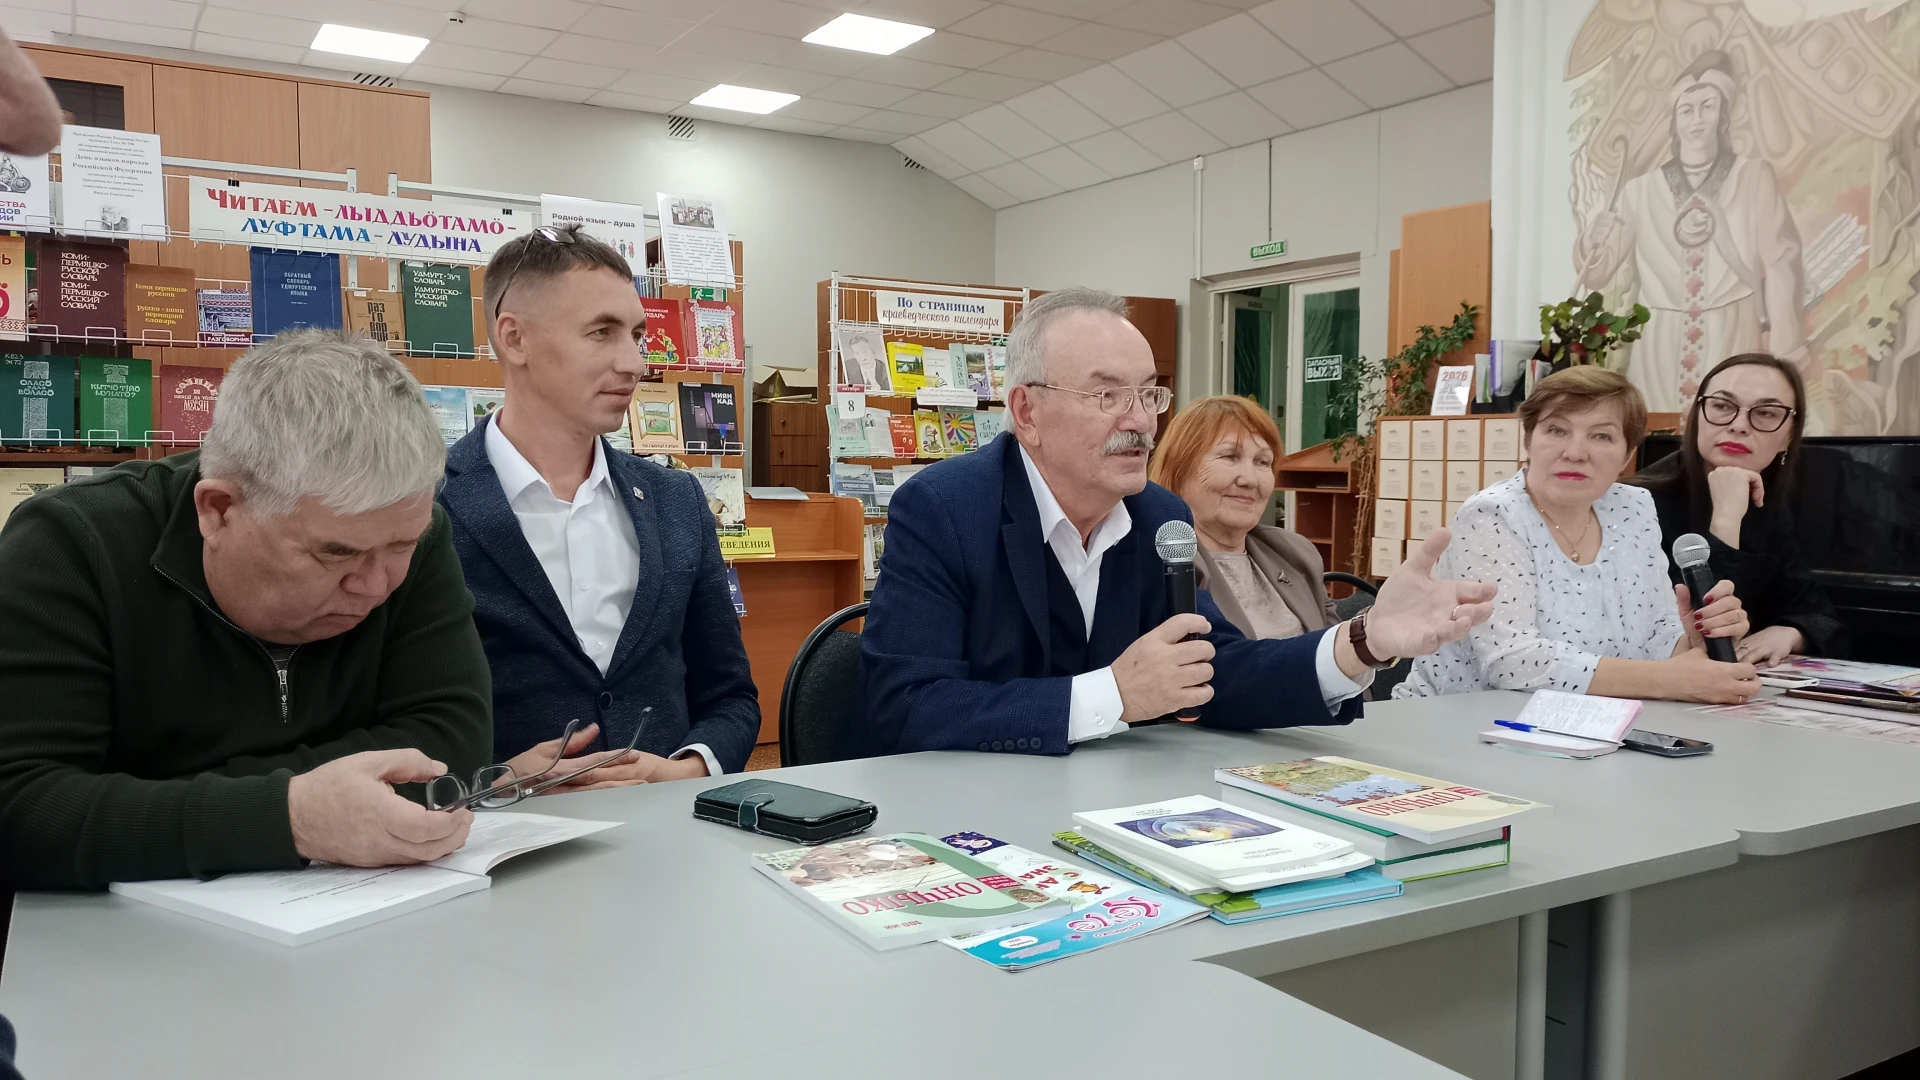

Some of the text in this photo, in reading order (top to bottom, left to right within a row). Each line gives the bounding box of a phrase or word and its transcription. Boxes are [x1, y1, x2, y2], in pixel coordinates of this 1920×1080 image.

[552, 213, 584, 222] Родной
[1253, 243, 1281, 256] ВЫХОД
[61, 252, 90, 260] КОМИ-
[61, 259, 110, 269] ПЕРМЯЦКО-
[61, 272, 98, 281] СЛОВАРЬ
[413, 278, 445, 286] СЛОВАРЬ
[61, 288, 110, 297] ПЕРМЯЦКО-
[414, 286, 462, 296] УДМУРТСКО-
[61, 294, 100, 303] РУССКИЙ
[414, 293, 448, 301] РУССКИЙ
[415, 299, 447, 307] СЛОВАРЬ
[897, 296, 985, 313] По СТРАНИЦАМ
[882, 309, 999, 330] краеведческого календаря
[1307, 357, 1339, 367] ЗАПАСНЫЙ
[1307, 365, 1340, 378] ВЫХД
[1443, 371, 1468, 381] 2026
[848, 400, 855, 412] 8
[842, 881, 983, 915] ОНЧЫКО
